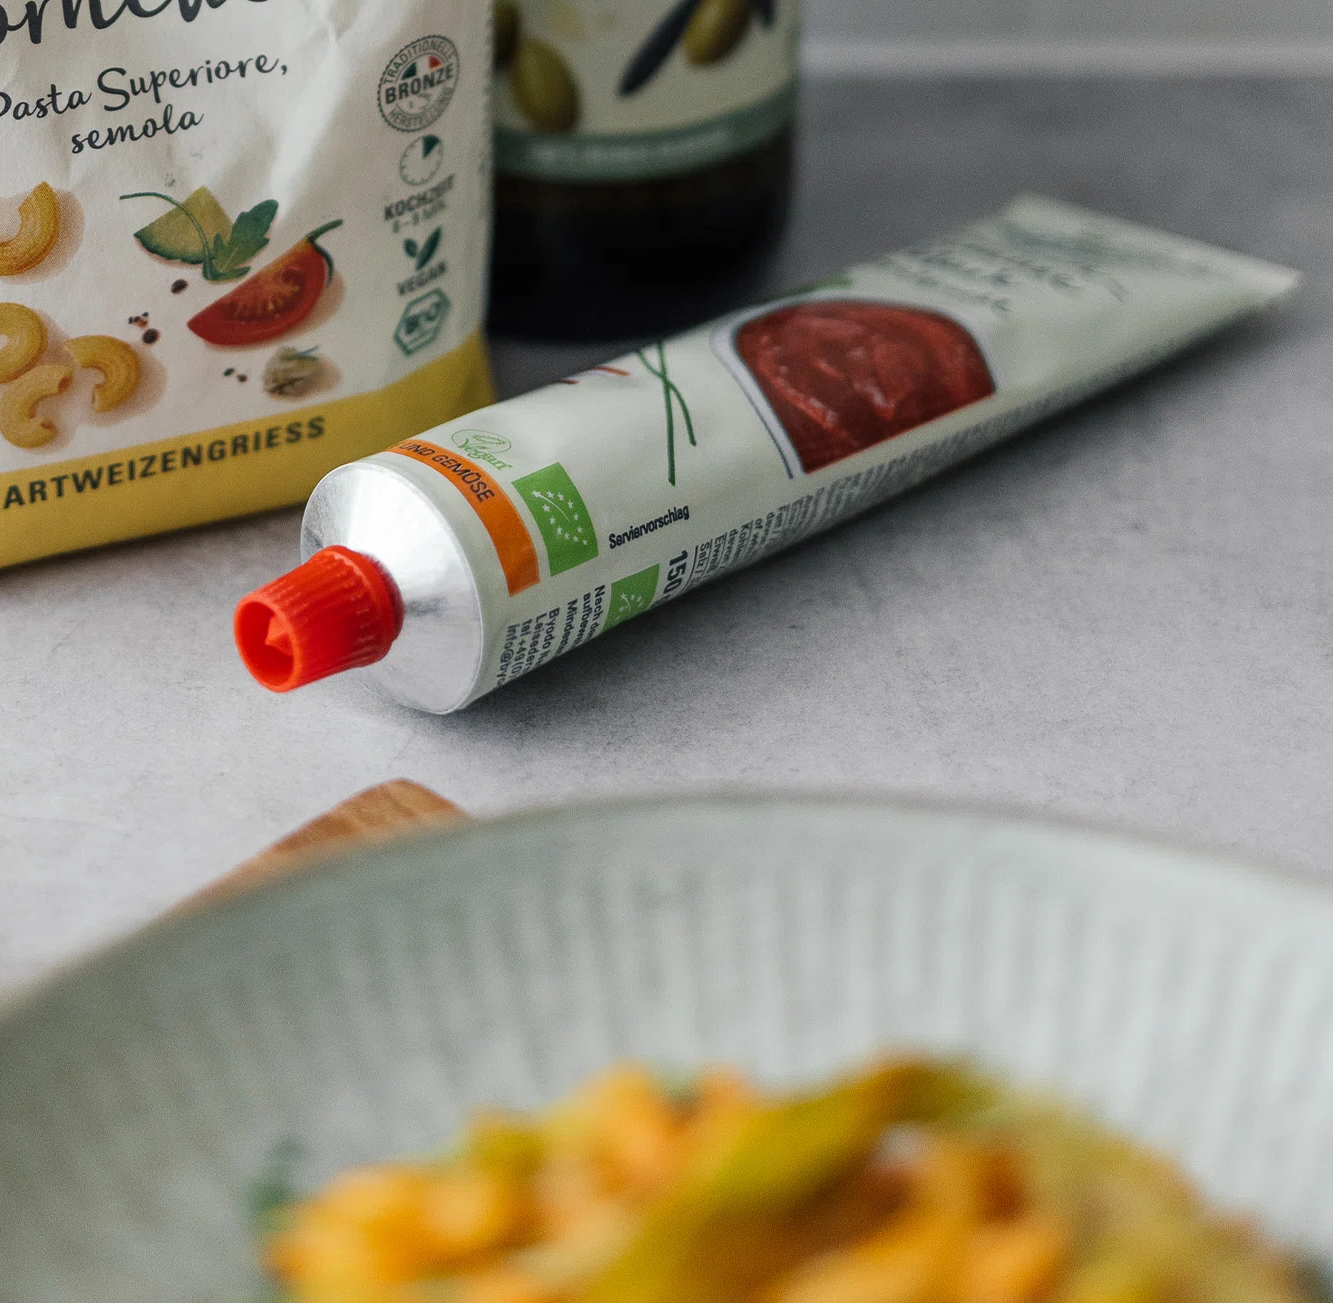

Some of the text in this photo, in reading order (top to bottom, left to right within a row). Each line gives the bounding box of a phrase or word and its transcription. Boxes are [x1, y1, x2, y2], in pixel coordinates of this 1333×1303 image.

[96, 52, 288, 112] Superiore,
[384, 63, 454, 106] BRONZE
[70, 103, 204, 155] semola
[399, 442, 496, 503] UND GEMÜSE
[608, 505, 691, 550] Serviervorschlag
[662, 549, 689, 601] 150
[593, 584, 606, 621] Nach
[543, 607, 560, 650] Byodo
